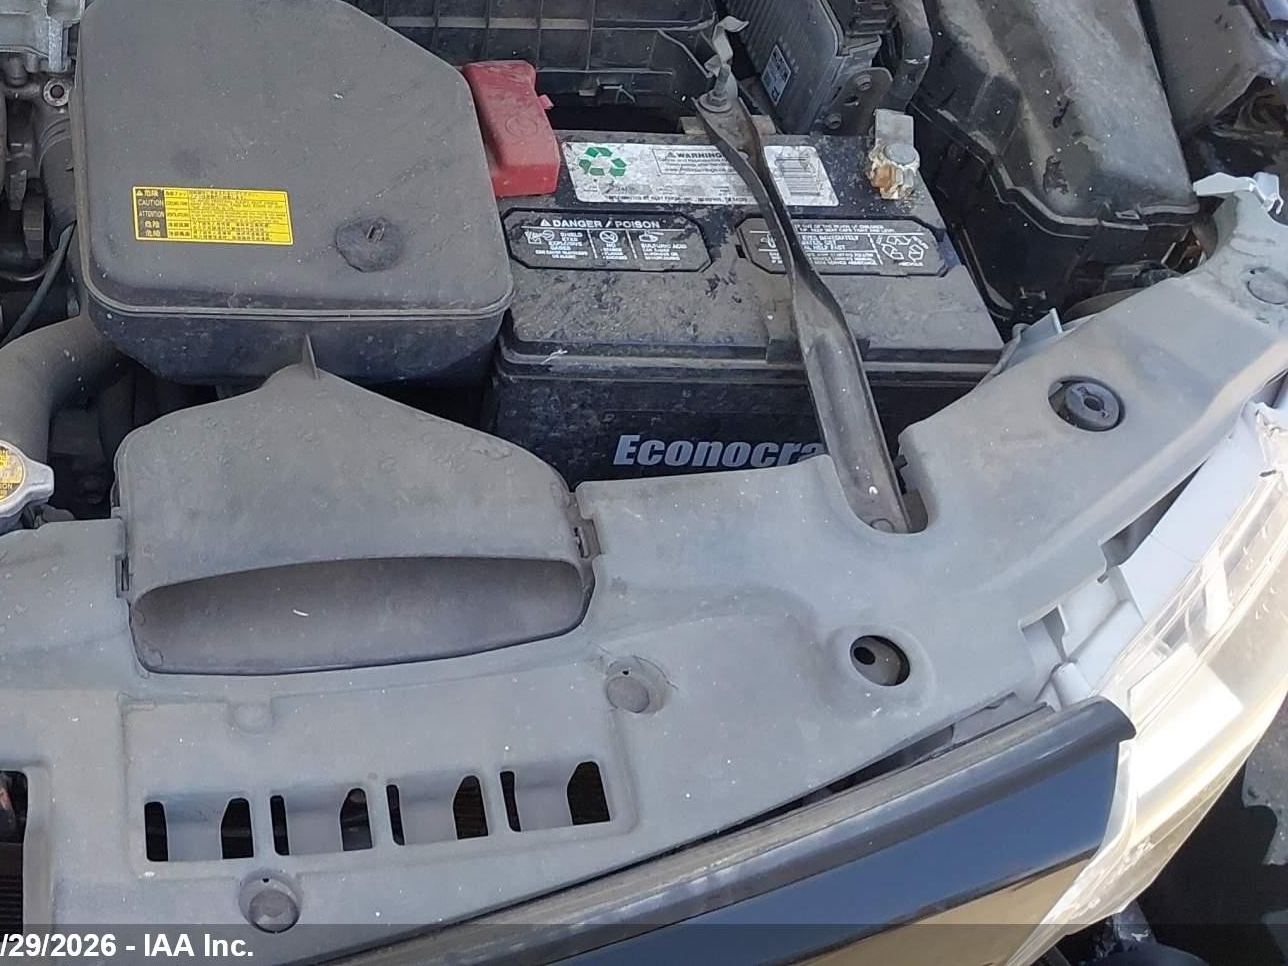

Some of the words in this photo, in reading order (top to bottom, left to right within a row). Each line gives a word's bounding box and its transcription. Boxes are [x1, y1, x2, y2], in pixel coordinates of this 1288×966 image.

[138, 198, 164, 206] CAUTION
[139, 210, 165, 218] ATTENTION
[553, 220, 602, 228] DANGER
[615, 221, 660, 229] POISON
